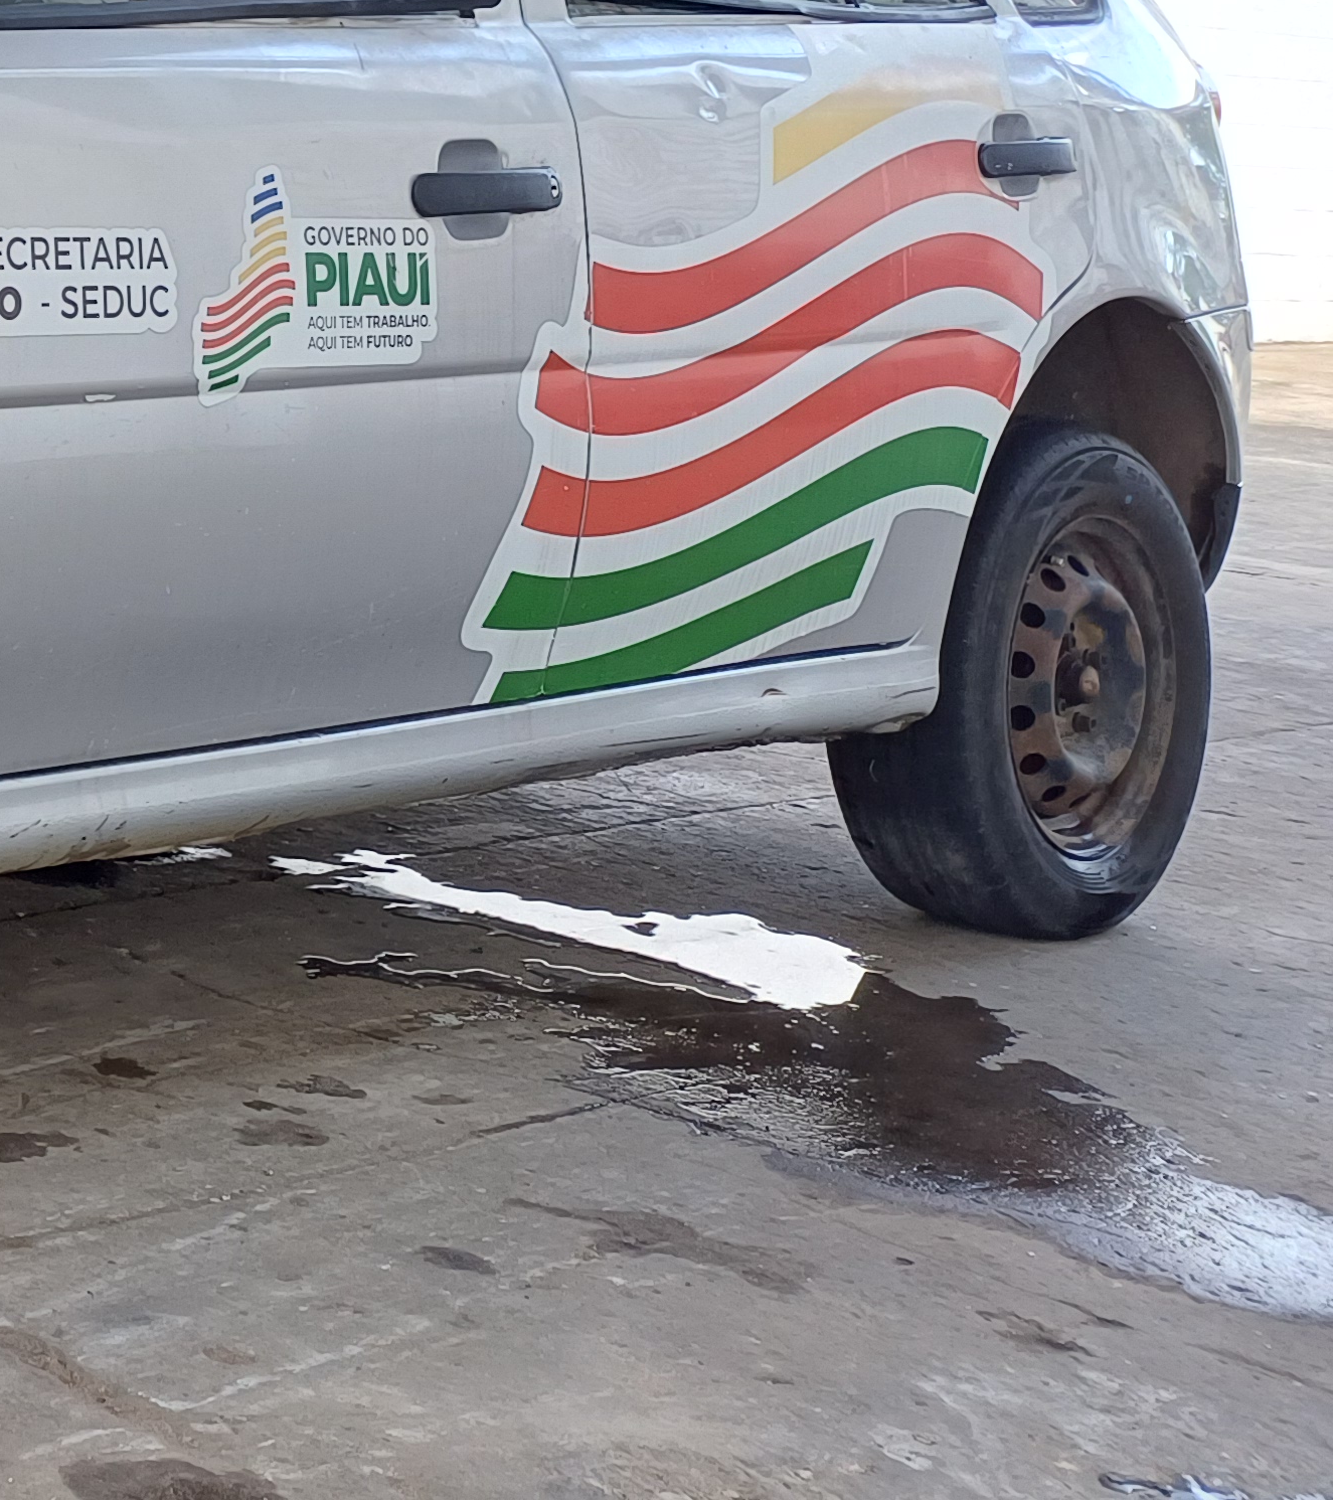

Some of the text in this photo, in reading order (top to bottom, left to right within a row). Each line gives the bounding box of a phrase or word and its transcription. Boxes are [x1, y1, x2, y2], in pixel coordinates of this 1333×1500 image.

[303, 225, 429, 246] GOVERNO DO
[305, 252, 430, 307] PIAUÍ
[61, 285, 170, 319] SEDUC
[307, 314, 431, 331] AQUI TEM TRABALHO.
[307, 334, 413, 352] AQUI TEM FUTURO
